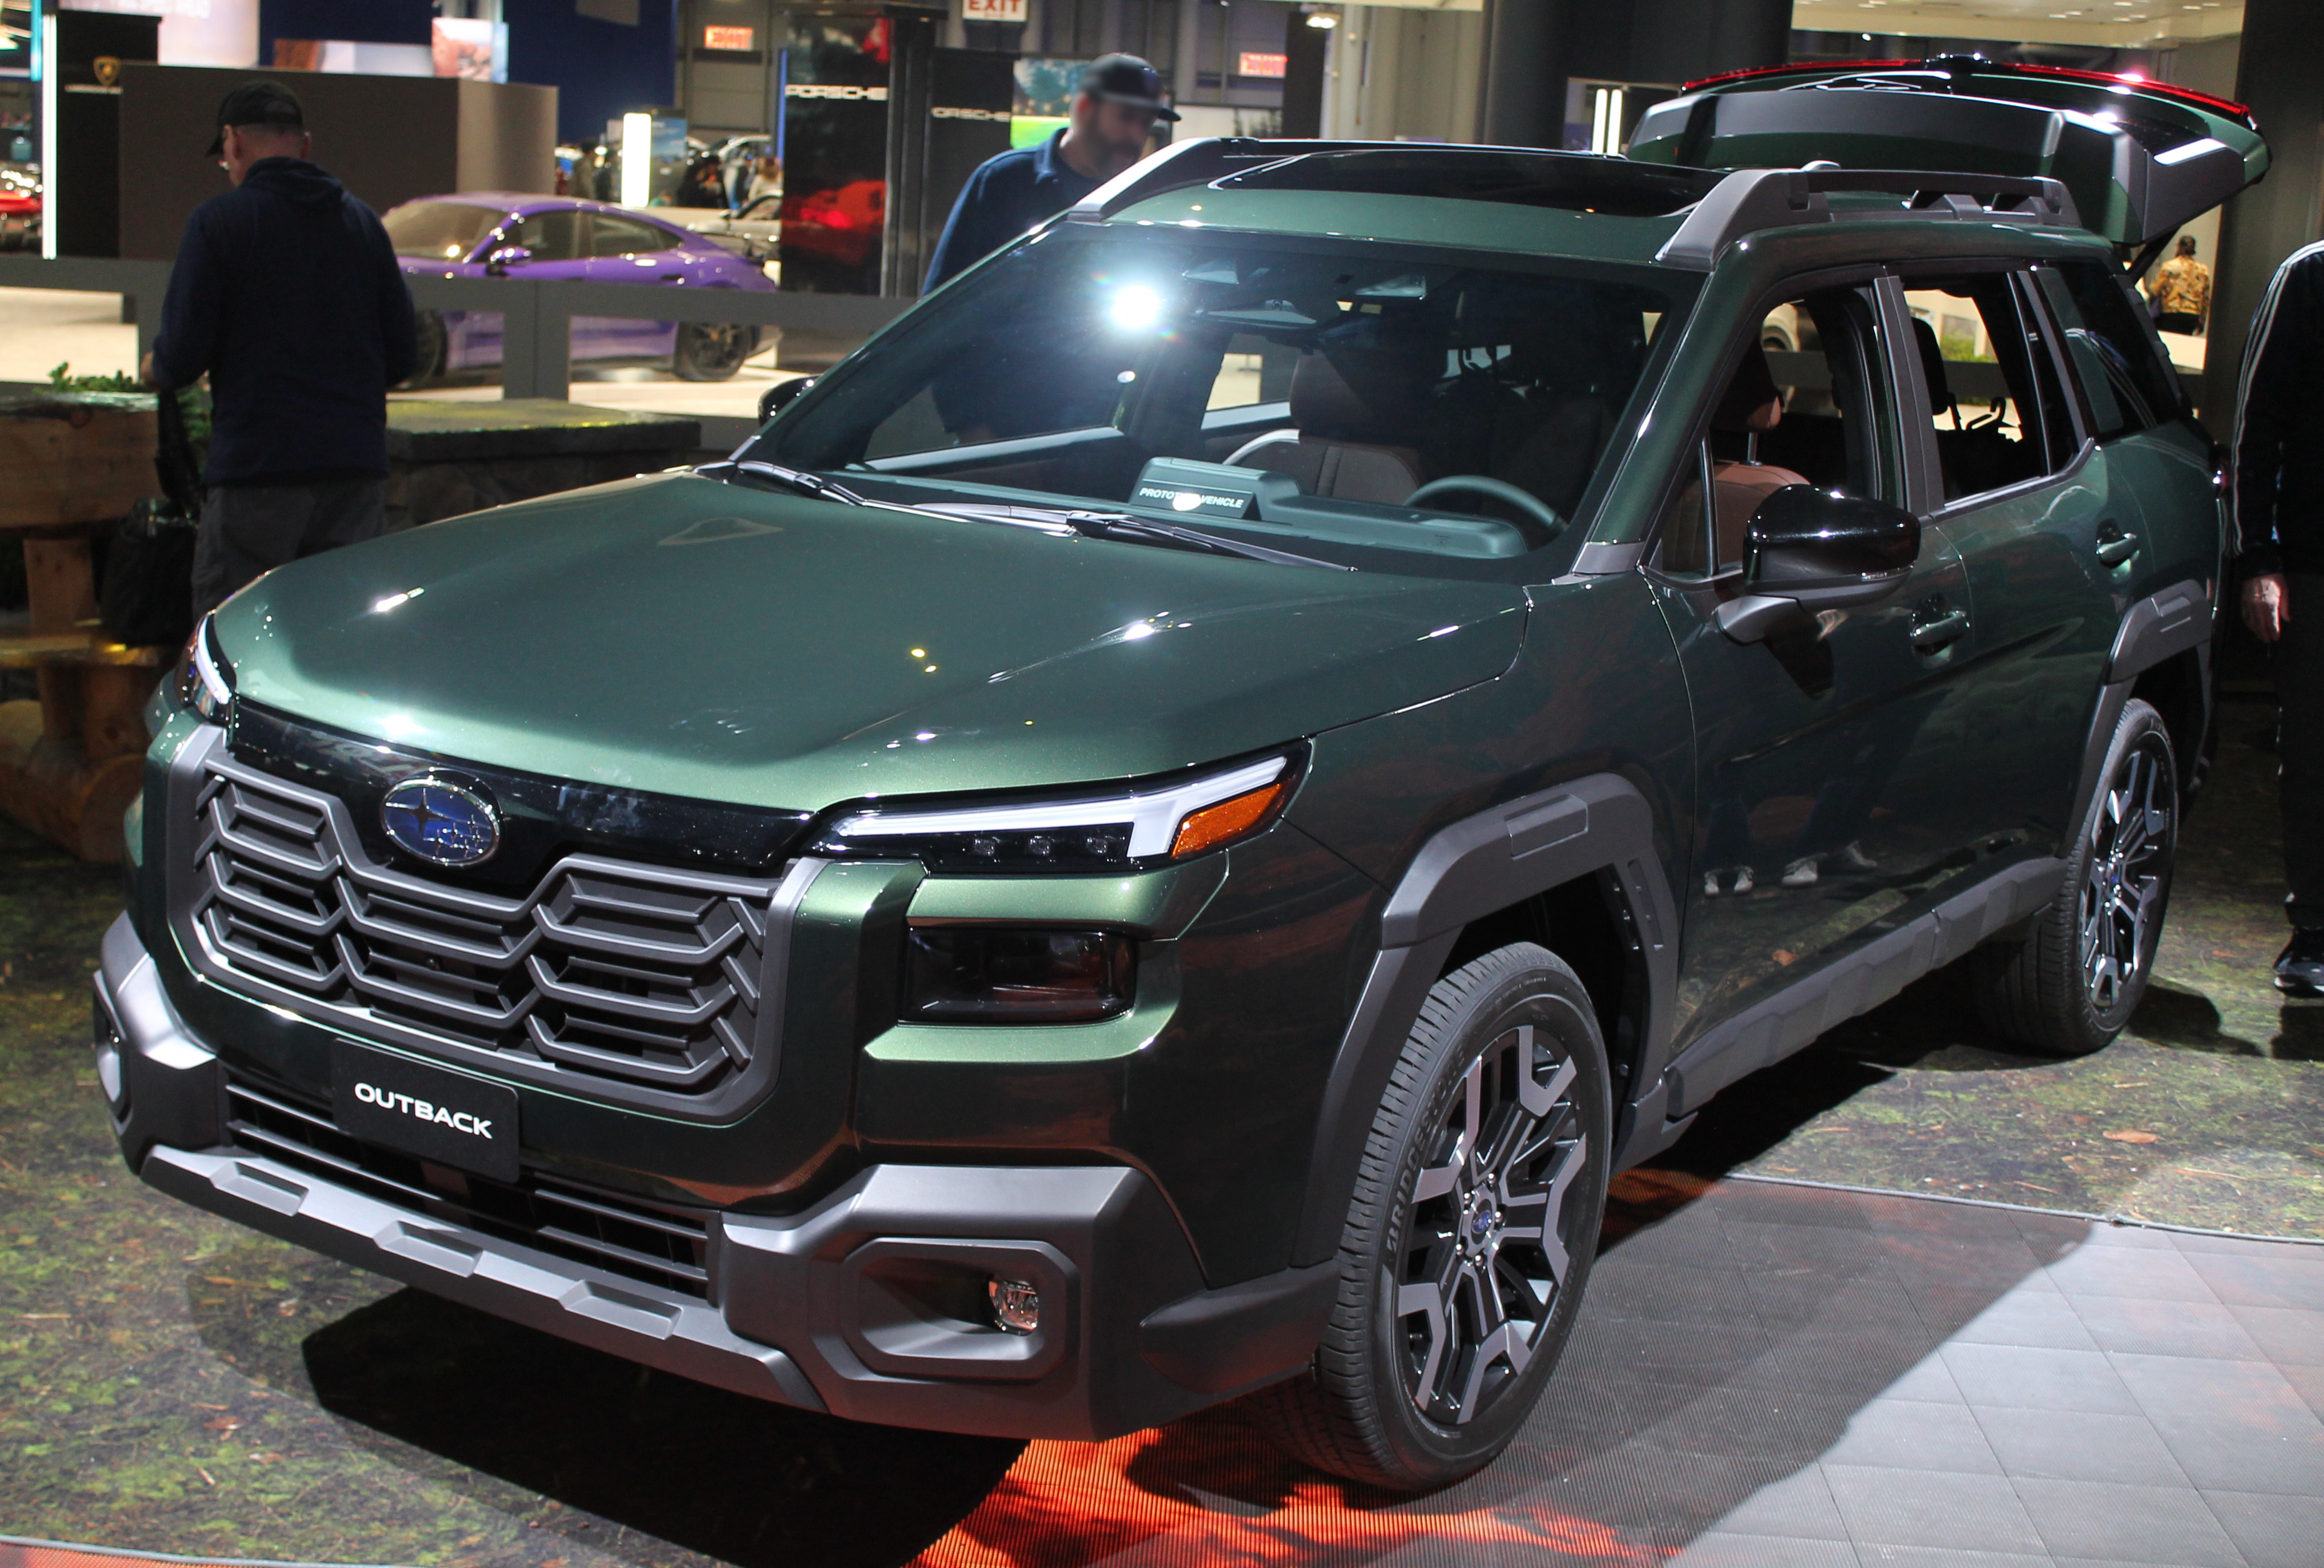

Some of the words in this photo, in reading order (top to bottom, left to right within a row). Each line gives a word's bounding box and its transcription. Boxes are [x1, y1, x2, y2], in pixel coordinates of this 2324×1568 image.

[969, 0, 1022, 12] EXIT
[708, 27, 752, 49] EXIT
[785, 84, 888, 100] PORSCHE
[932, 107, 1011, 122] ORSCHE
[1139, 487, 1200, 505] PROTOT
[1201, 495, 1244, 508] VEHICLE
[354, 1082, 493, 1140] OUTBACK
